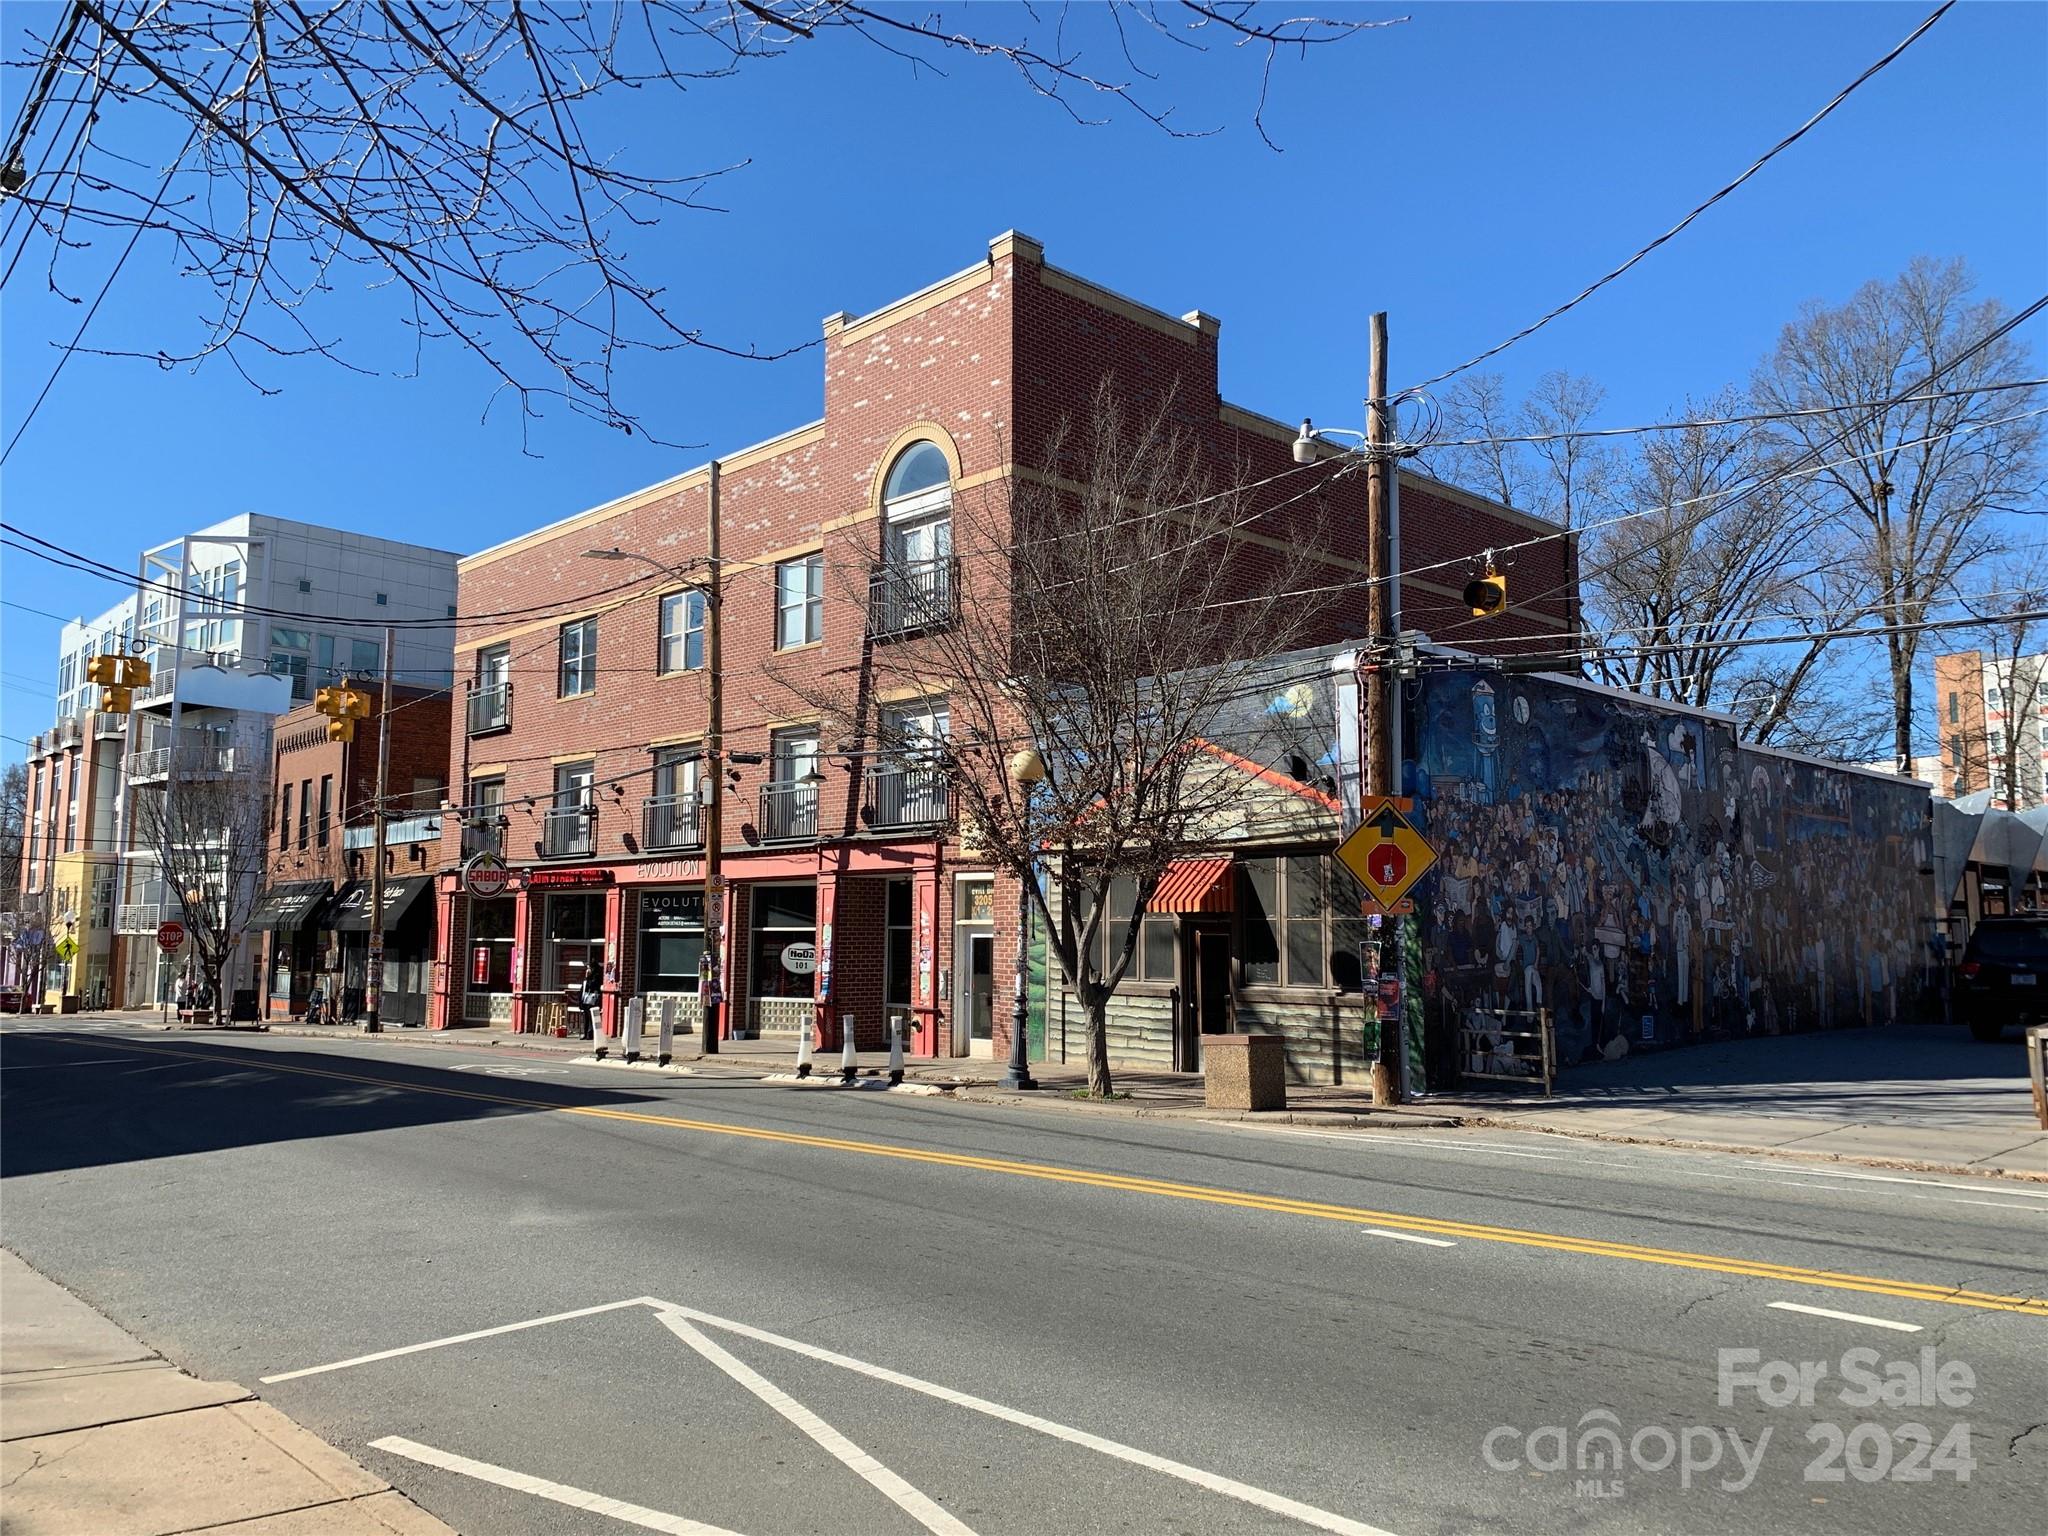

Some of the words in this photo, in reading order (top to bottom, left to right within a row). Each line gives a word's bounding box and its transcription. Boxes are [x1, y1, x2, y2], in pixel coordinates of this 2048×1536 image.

[637, 859, 700, 879] EVOLUTION
[468, 870, 507, 882] SABOR
[642, 896, 705, 908] EVOLUTI
[974, 894, 993, 906] 3205
[159, 931, 183, 942] STOP
[795, 961, 808, 969] 101
